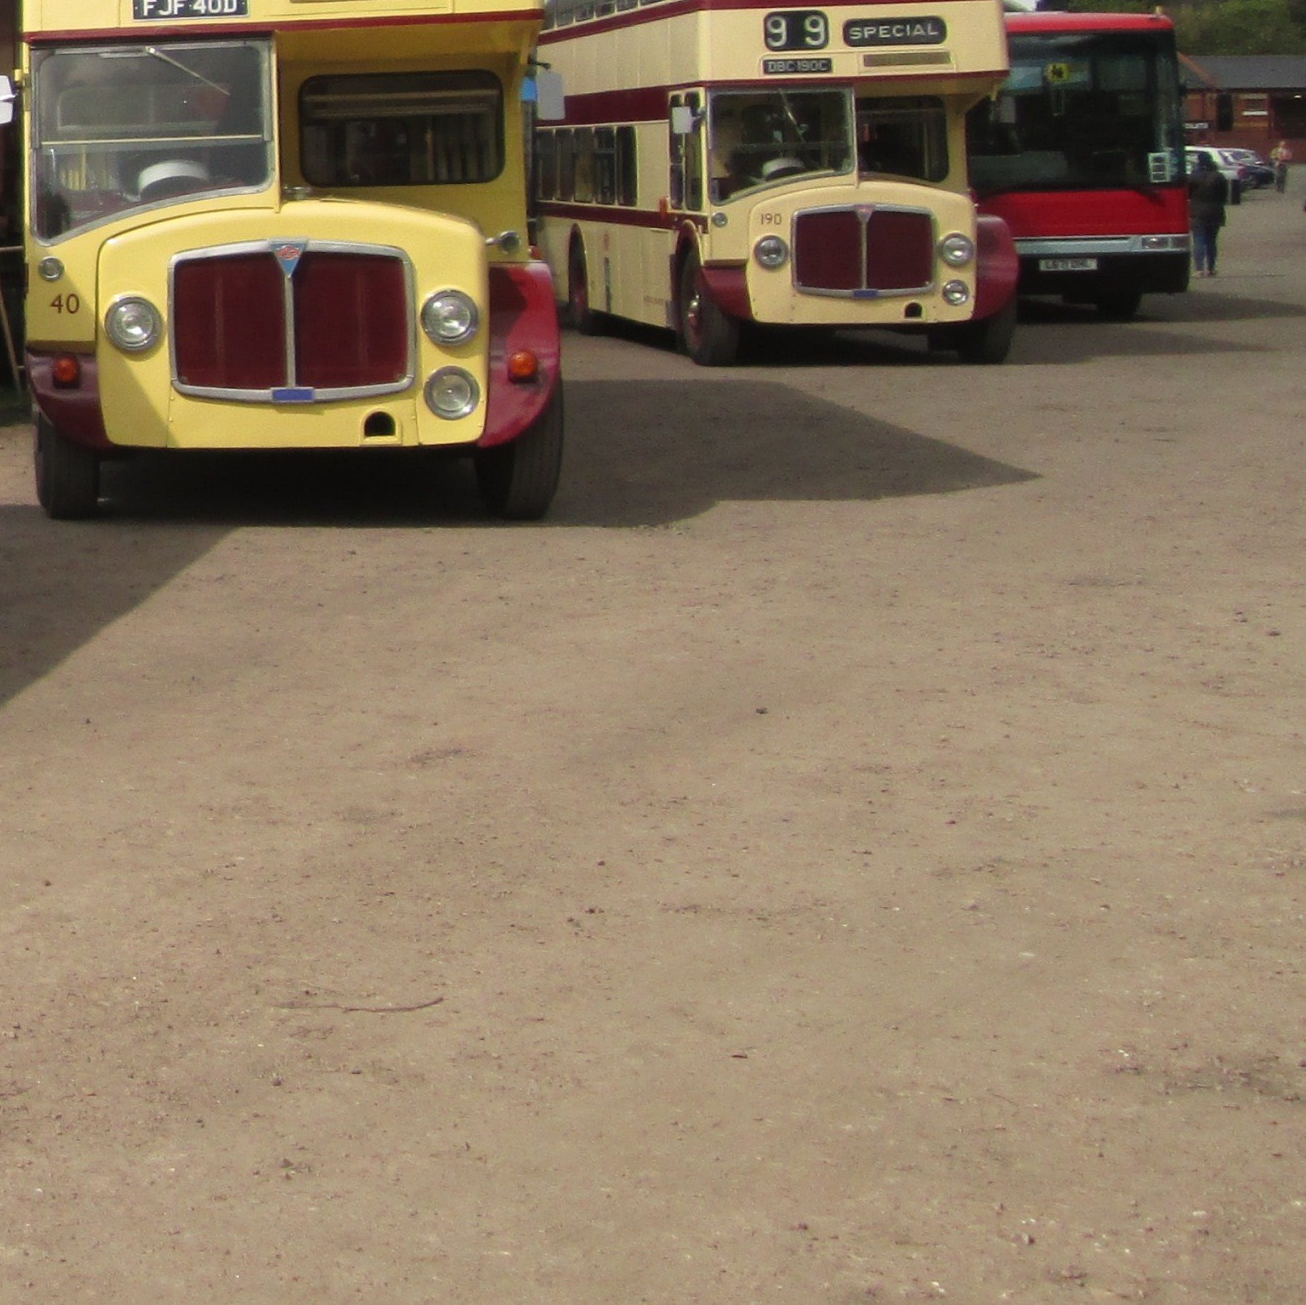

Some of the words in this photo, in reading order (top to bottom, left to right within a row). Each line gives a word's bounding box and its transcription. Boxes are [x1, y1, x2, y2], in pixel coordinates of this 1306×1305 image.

[849, 23, 938, 40] SPECIAL
[760, 213, 782, 225] 190
[49, 294, 80, 314] 40
